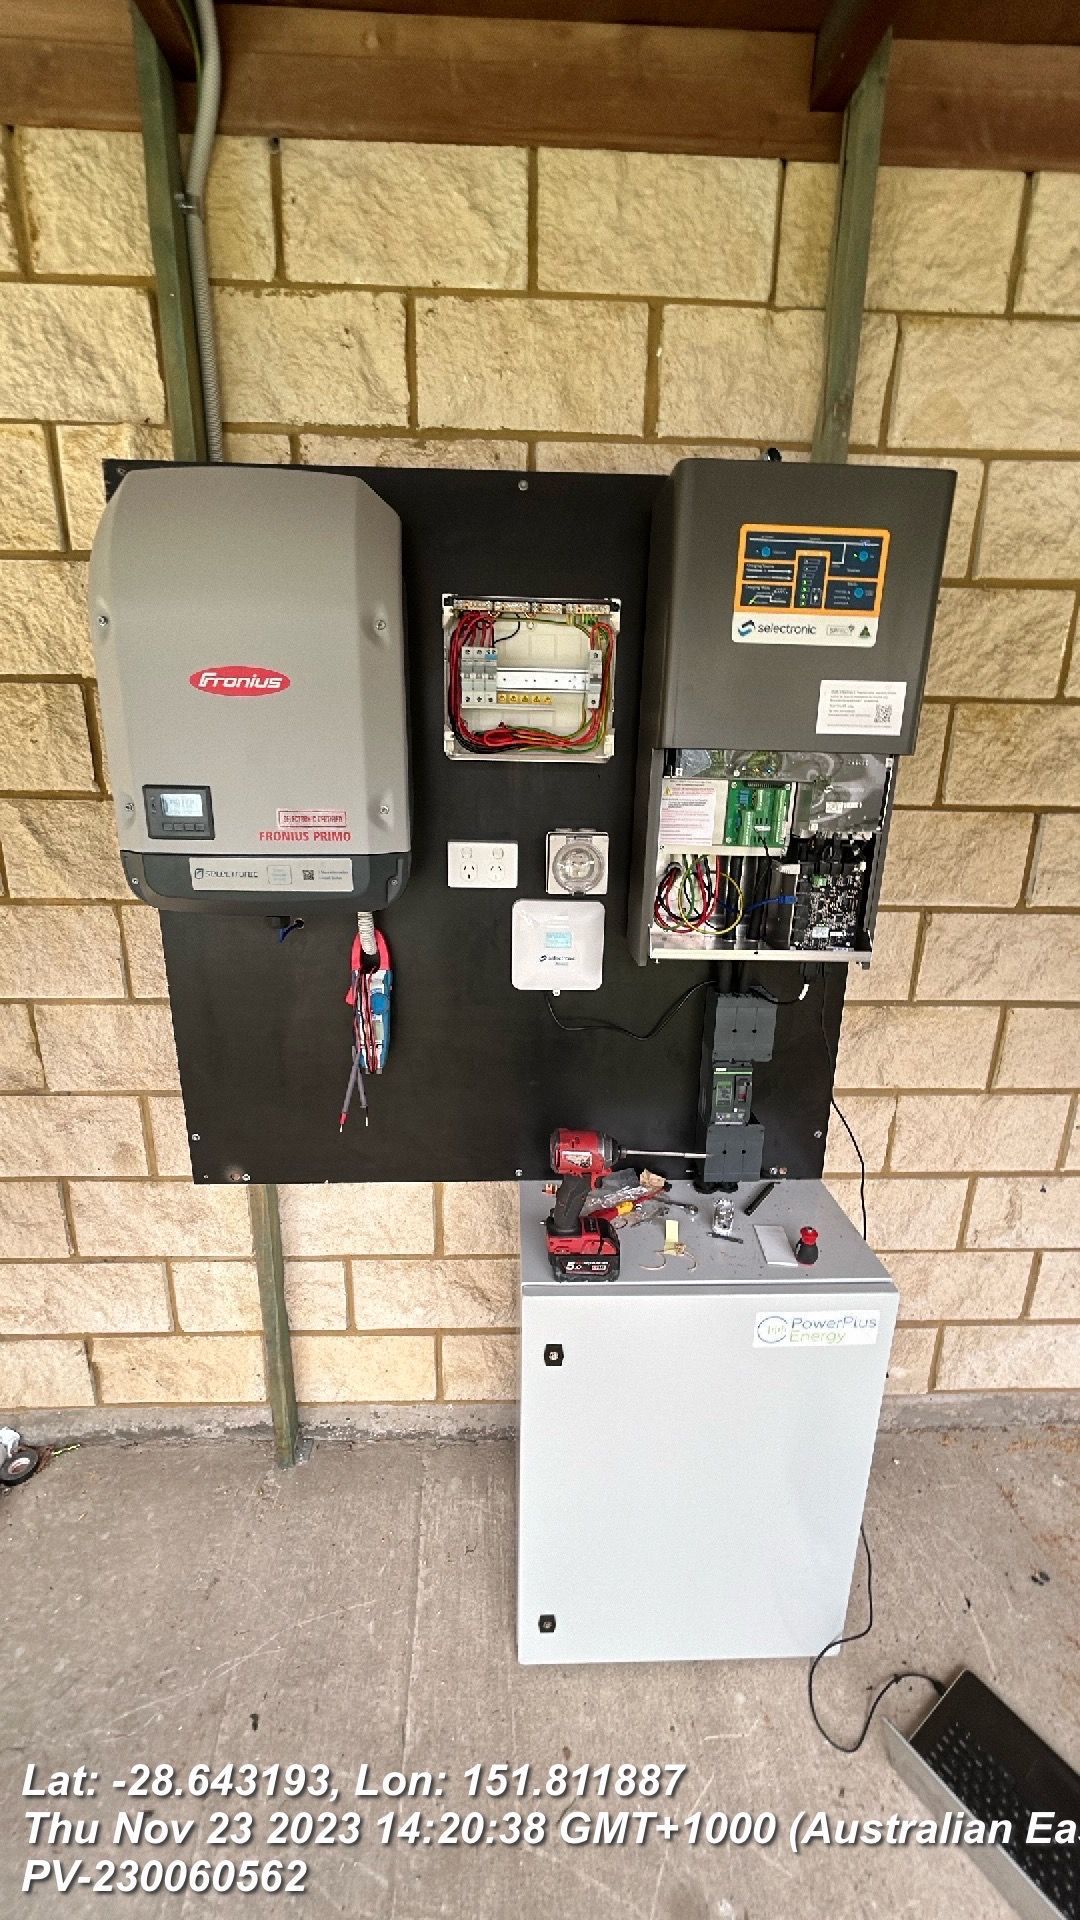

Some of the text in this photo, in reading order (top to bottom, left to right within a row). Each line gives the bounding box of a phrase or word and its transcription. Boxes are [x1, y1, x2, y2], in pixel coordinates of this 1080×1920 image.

[757, 621, 817, 635] selectronic
[199, 672, 283, 689] Fronius
[259, 831, 352, 842] FRONIUS PRIMO
[791, 1315, 877, 1329] PowerPlus
[789, 1330, 846, 1344] Energy
